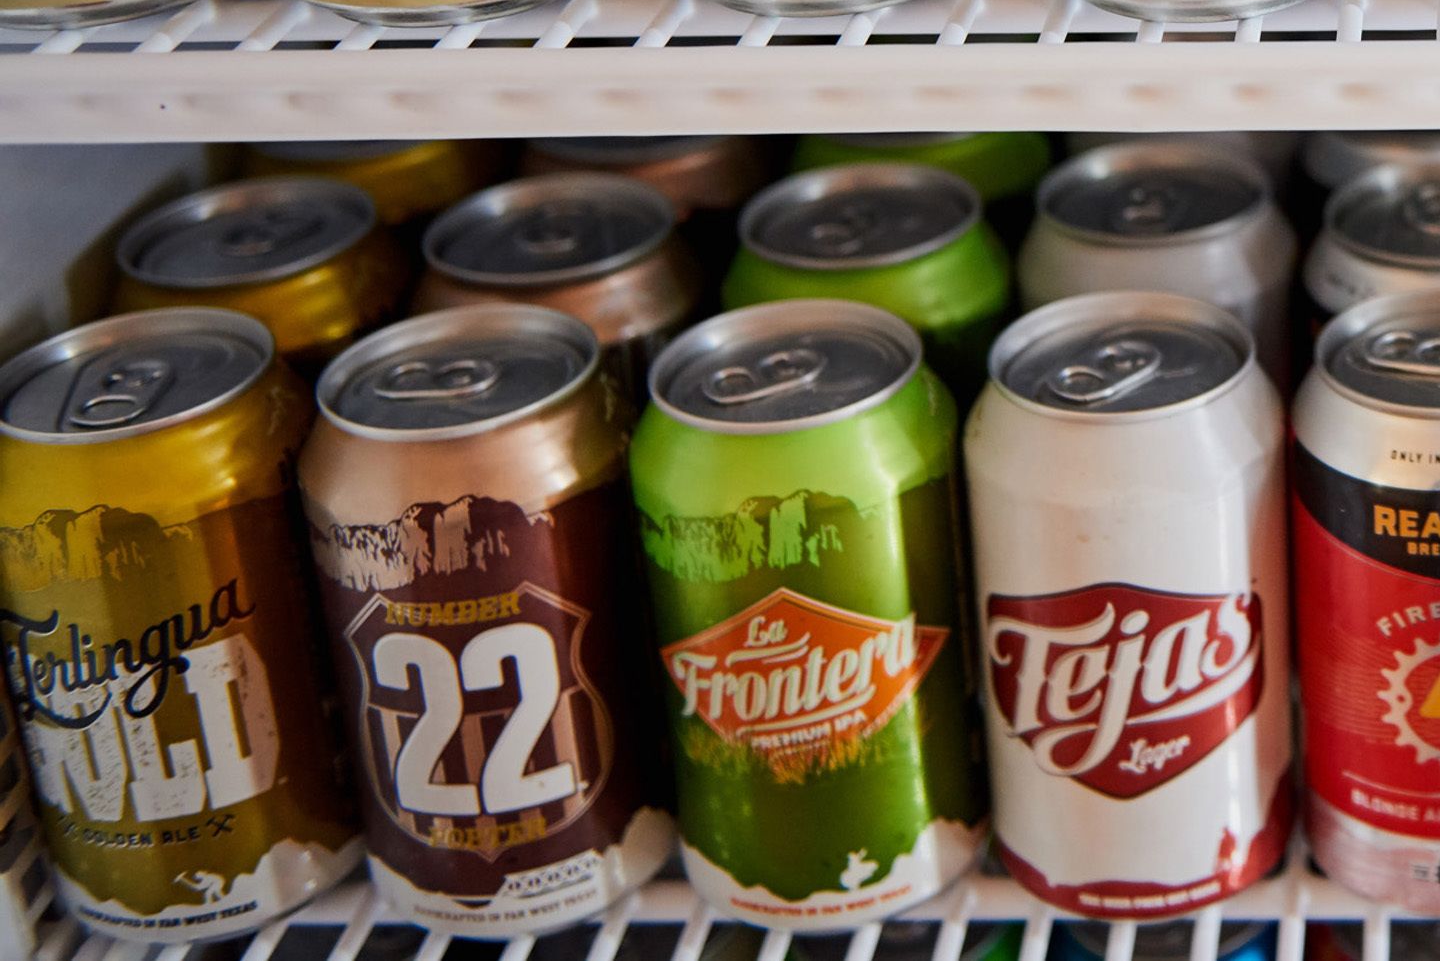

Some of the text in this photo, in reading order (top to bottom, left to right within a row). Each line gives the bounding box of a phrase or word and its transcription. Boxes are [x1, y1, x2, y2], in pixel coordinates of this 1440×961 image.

[1390, 449, 1423, 464] ONLY
[385, 591, 522, 627] NUMBER
[744, 616, 788, 648] La
[0, 577, 257, 729] Terlingua
[673, 613, 918, 722] Frontera
[988, 591, 1252, 777] Tejas
[372, 621, 579, 817] 22
[1118, 736, 1191, 775] Lager
